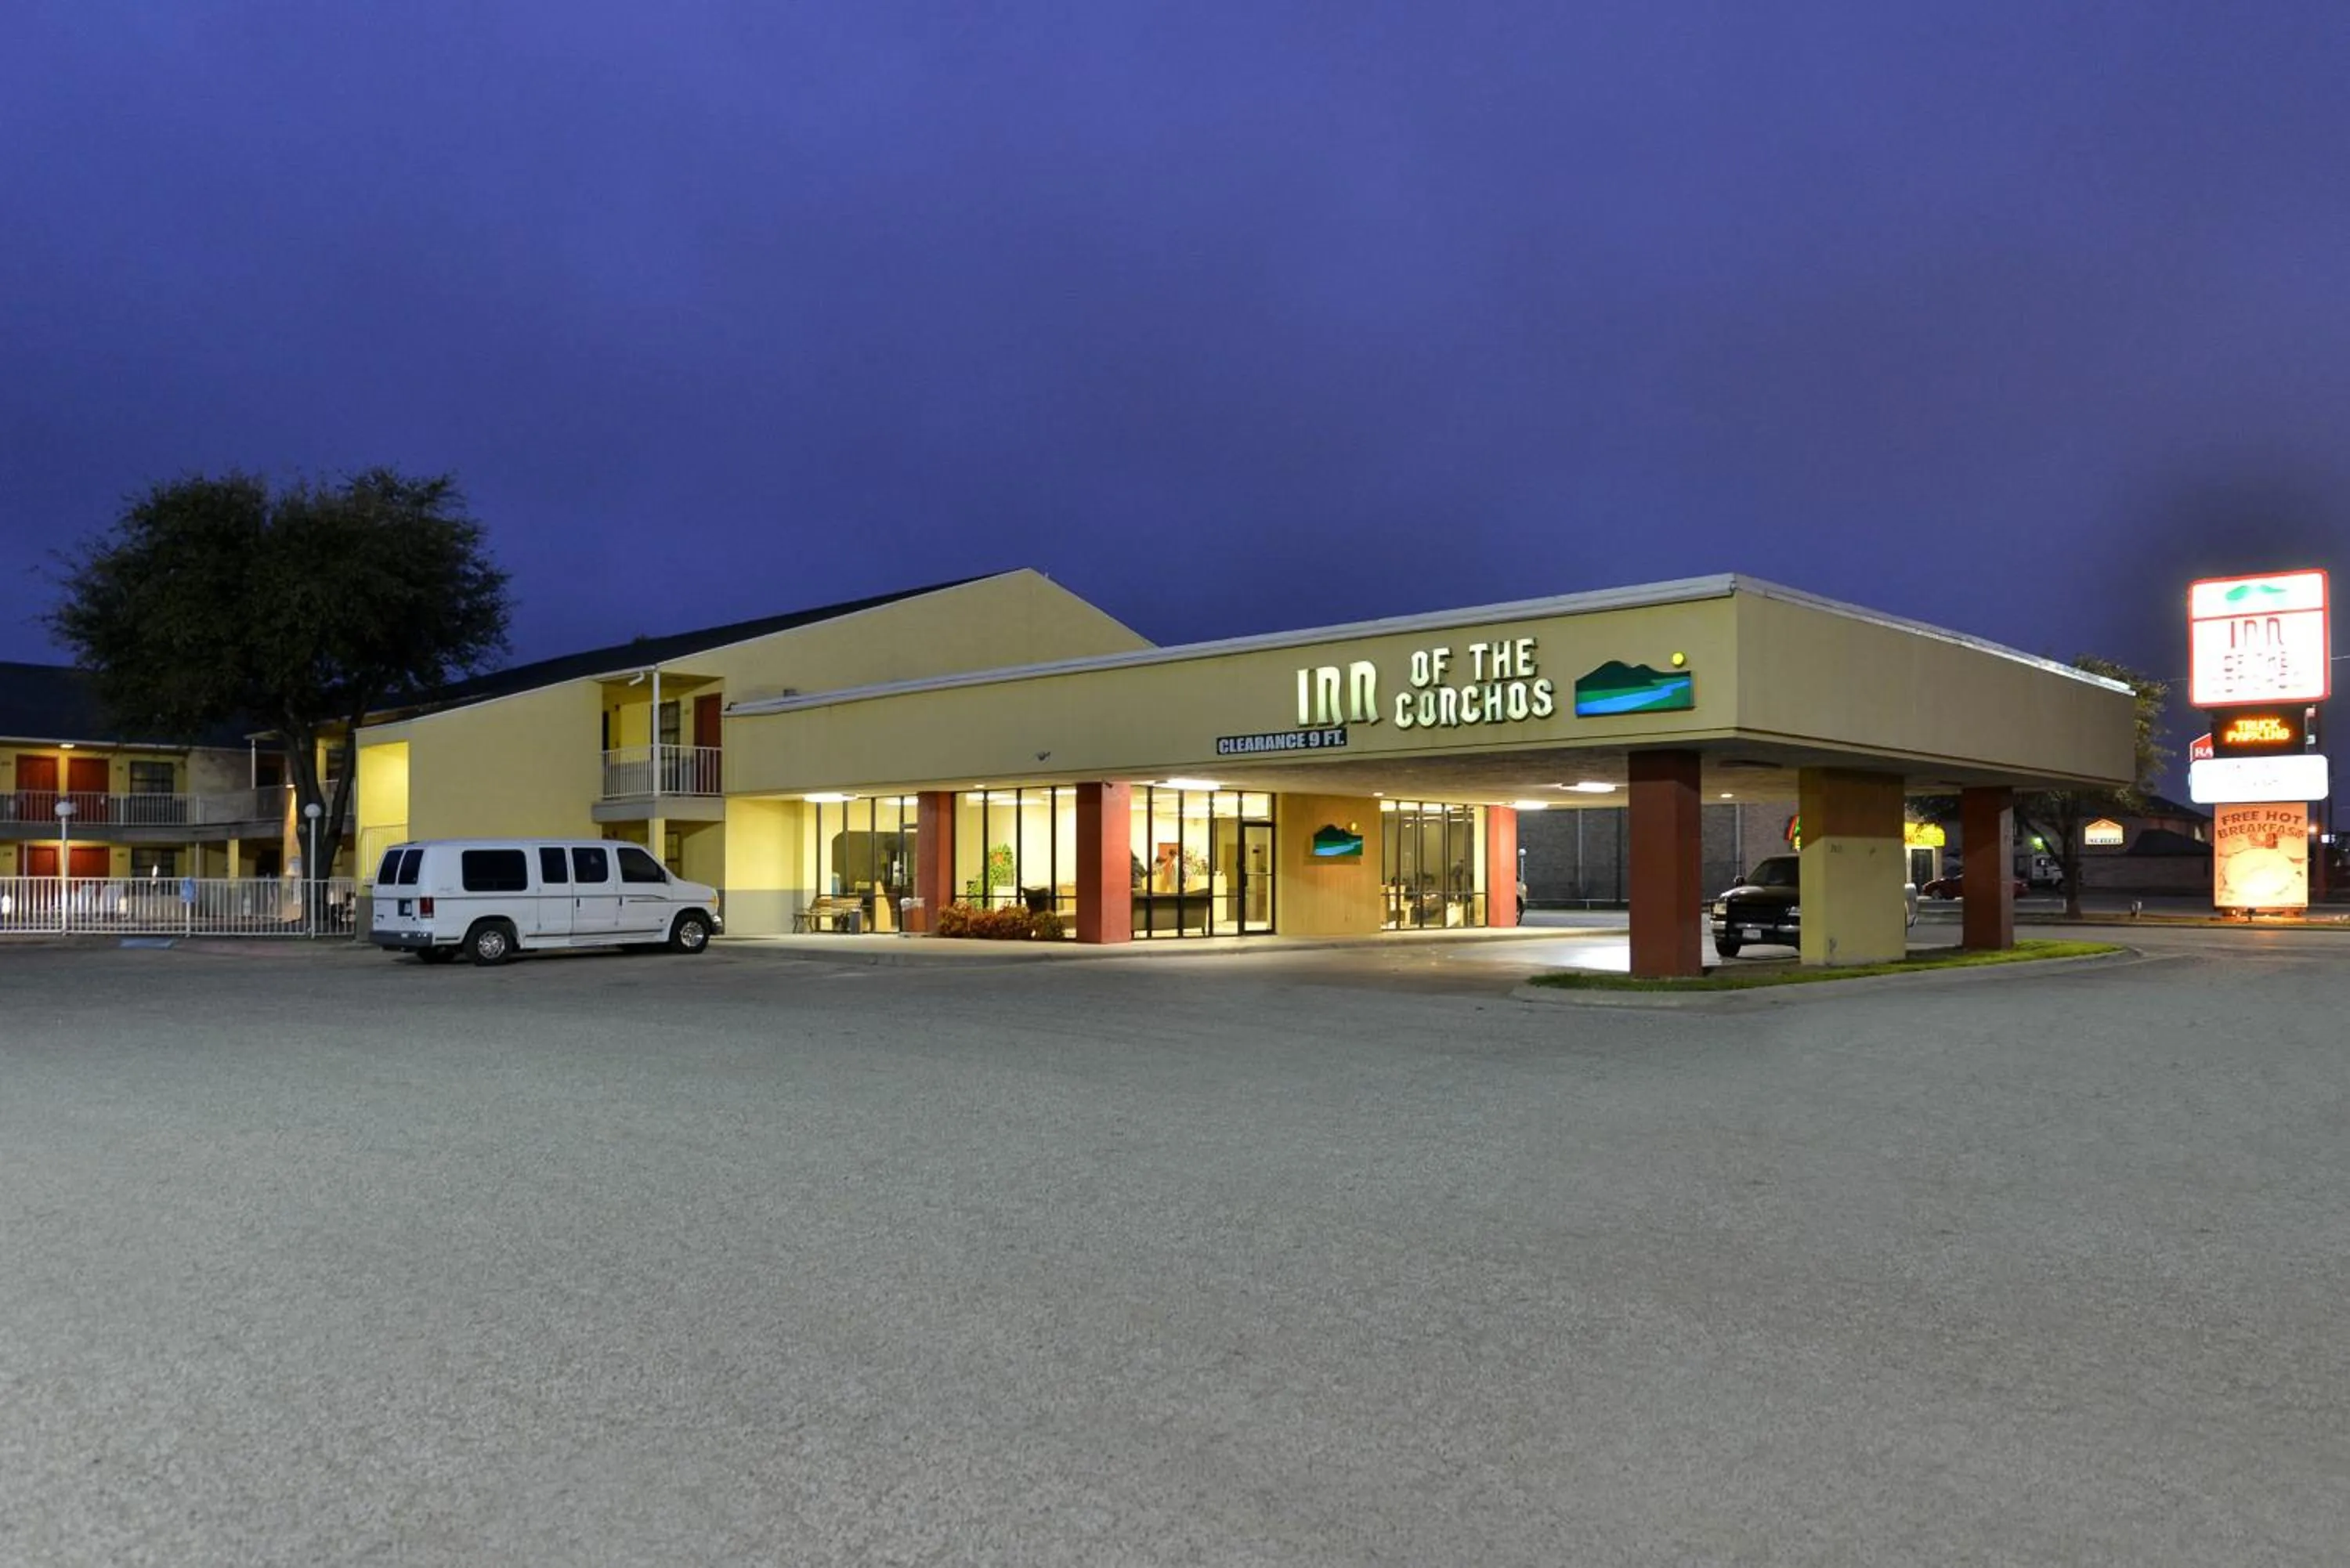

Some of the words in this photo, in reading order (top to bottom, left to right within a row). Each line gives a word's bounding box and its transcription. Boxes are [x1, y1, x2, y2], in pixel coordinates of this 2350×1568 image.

[1411, 648, 1451, 687] OF
[1469, 638, 1535, 681] THE
[1297, 661, 1380, 725] INN
[1395, 678, 1554, 729] CONCHOS
[1219, 732, 1306, 753] CLEARANCE
[1309, 732, 1320, 746] 9
[1324, 729, 1344, 745] FT.
[2236, 718, 2280, 731] TRUCK
[2222, 811, 2259, 826] FREE
[2265, 811, 2302, 824] HOT
